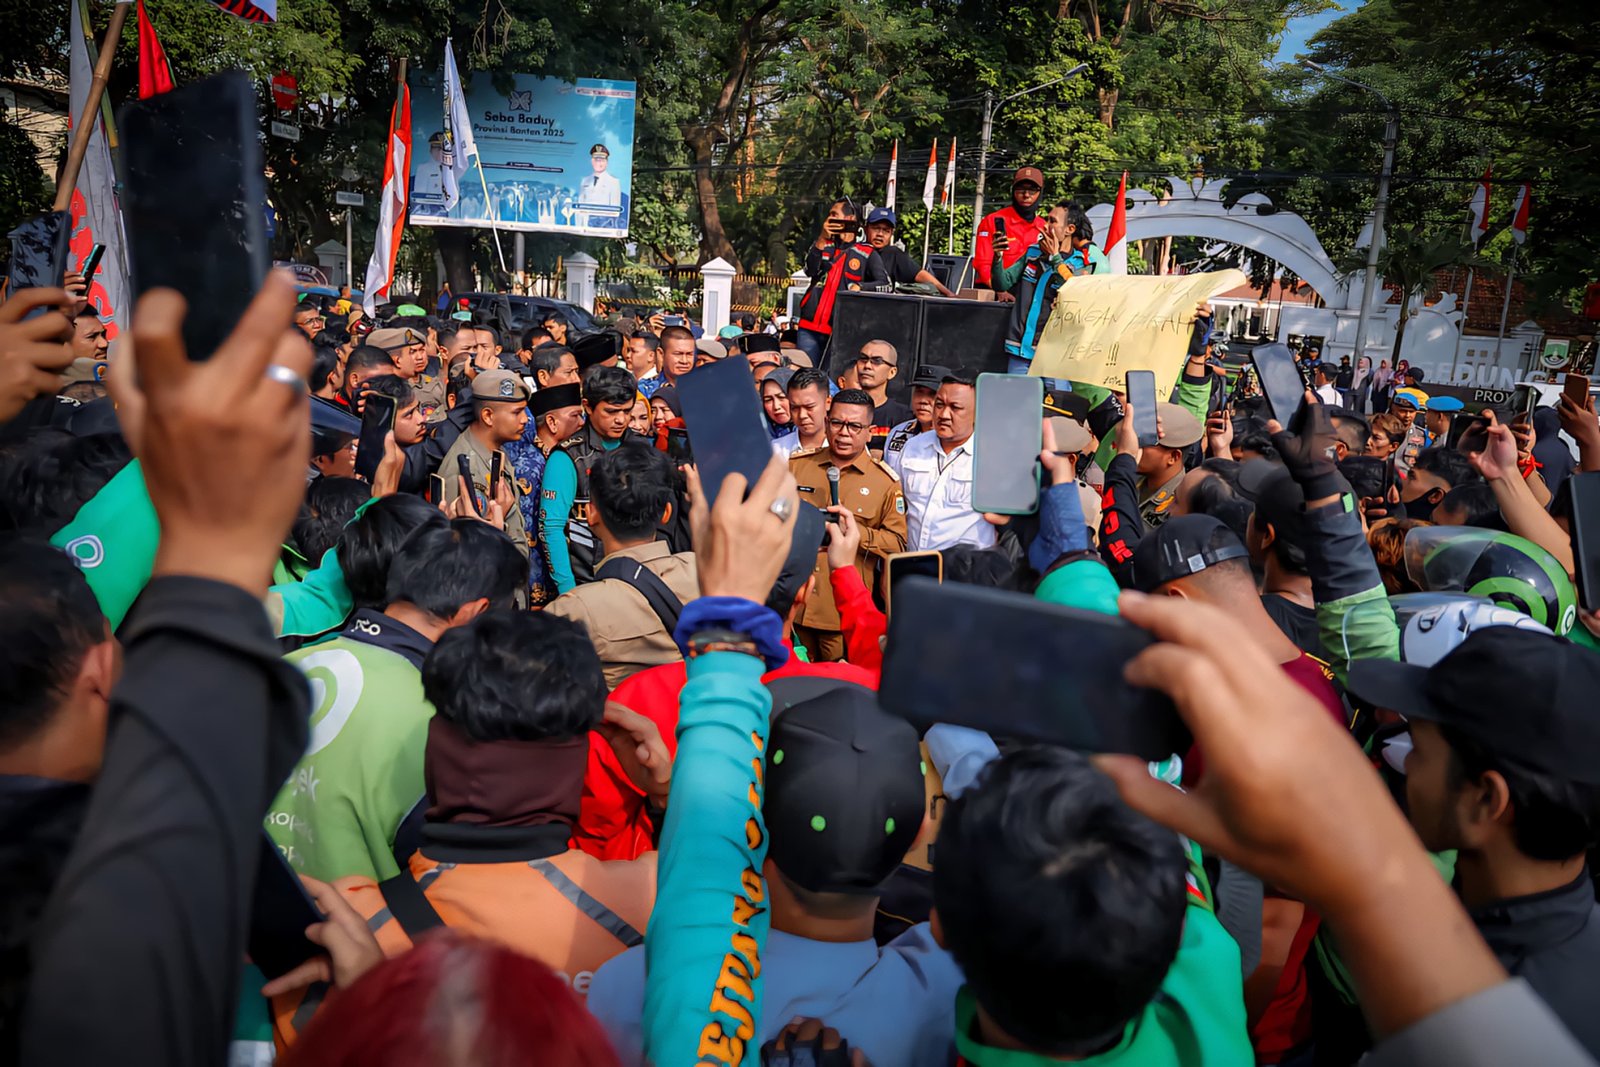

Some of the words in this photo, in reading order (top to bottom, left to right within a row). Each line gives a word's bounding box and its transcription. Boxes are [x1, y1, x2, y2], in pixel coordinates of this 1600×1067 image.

[484, 111, 515, 123] Seba
[518, 113, 555, 128] Baduy
[474, 123, 508, 134] Provinsi
[510, 126, 541, 136] Banten
[543, 129, 565, 138] 2025
